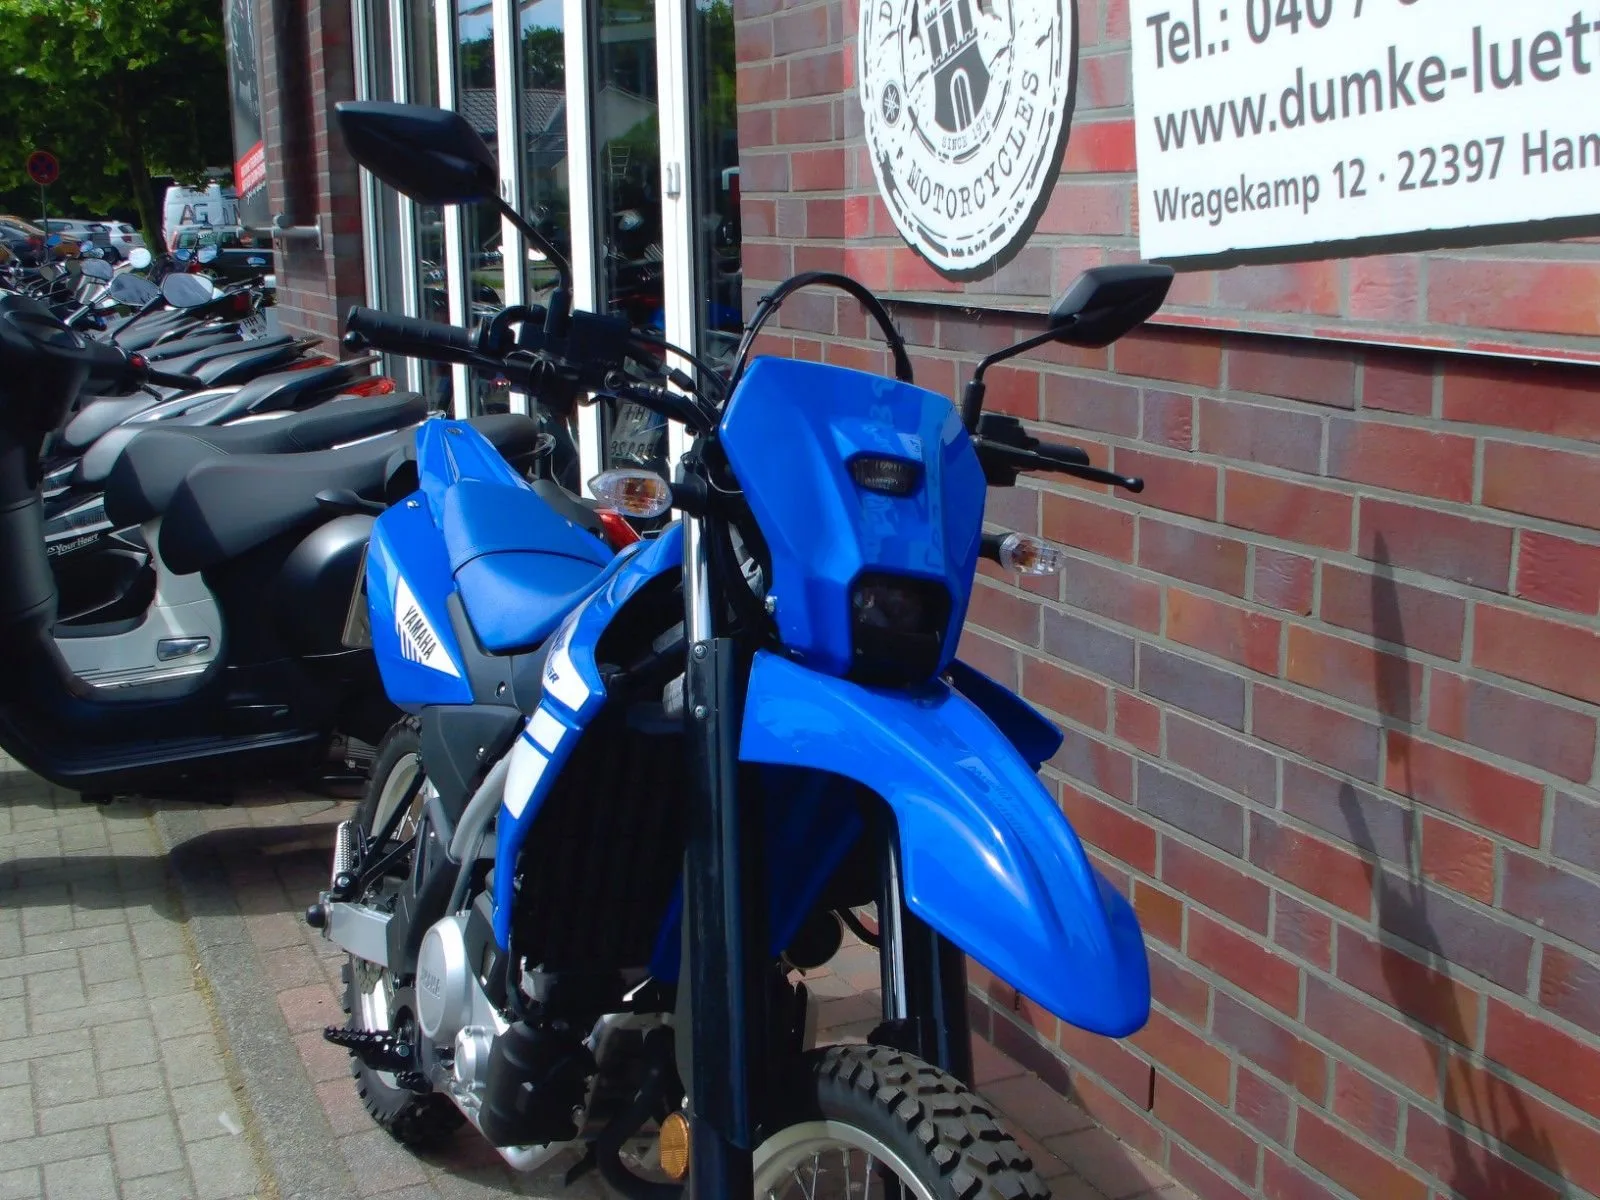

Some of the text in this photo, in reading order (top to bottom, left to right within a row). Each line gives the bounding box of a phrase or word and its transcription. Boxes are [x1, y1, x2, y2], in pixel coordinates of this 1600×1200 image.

[1146, 0, 1229, 69] Tel.:
[1153, 10, 1600, 152] www.dumke-luet
[906, 69, 1040, 221] MOTORCYCLES
[1153, 174, 1320, 227] Wragekamp
[1332, 158, 1367, 199] 12
[1397, 135, 1505, 192] 22397
[402, 605, 437, 661] YAMAHA
